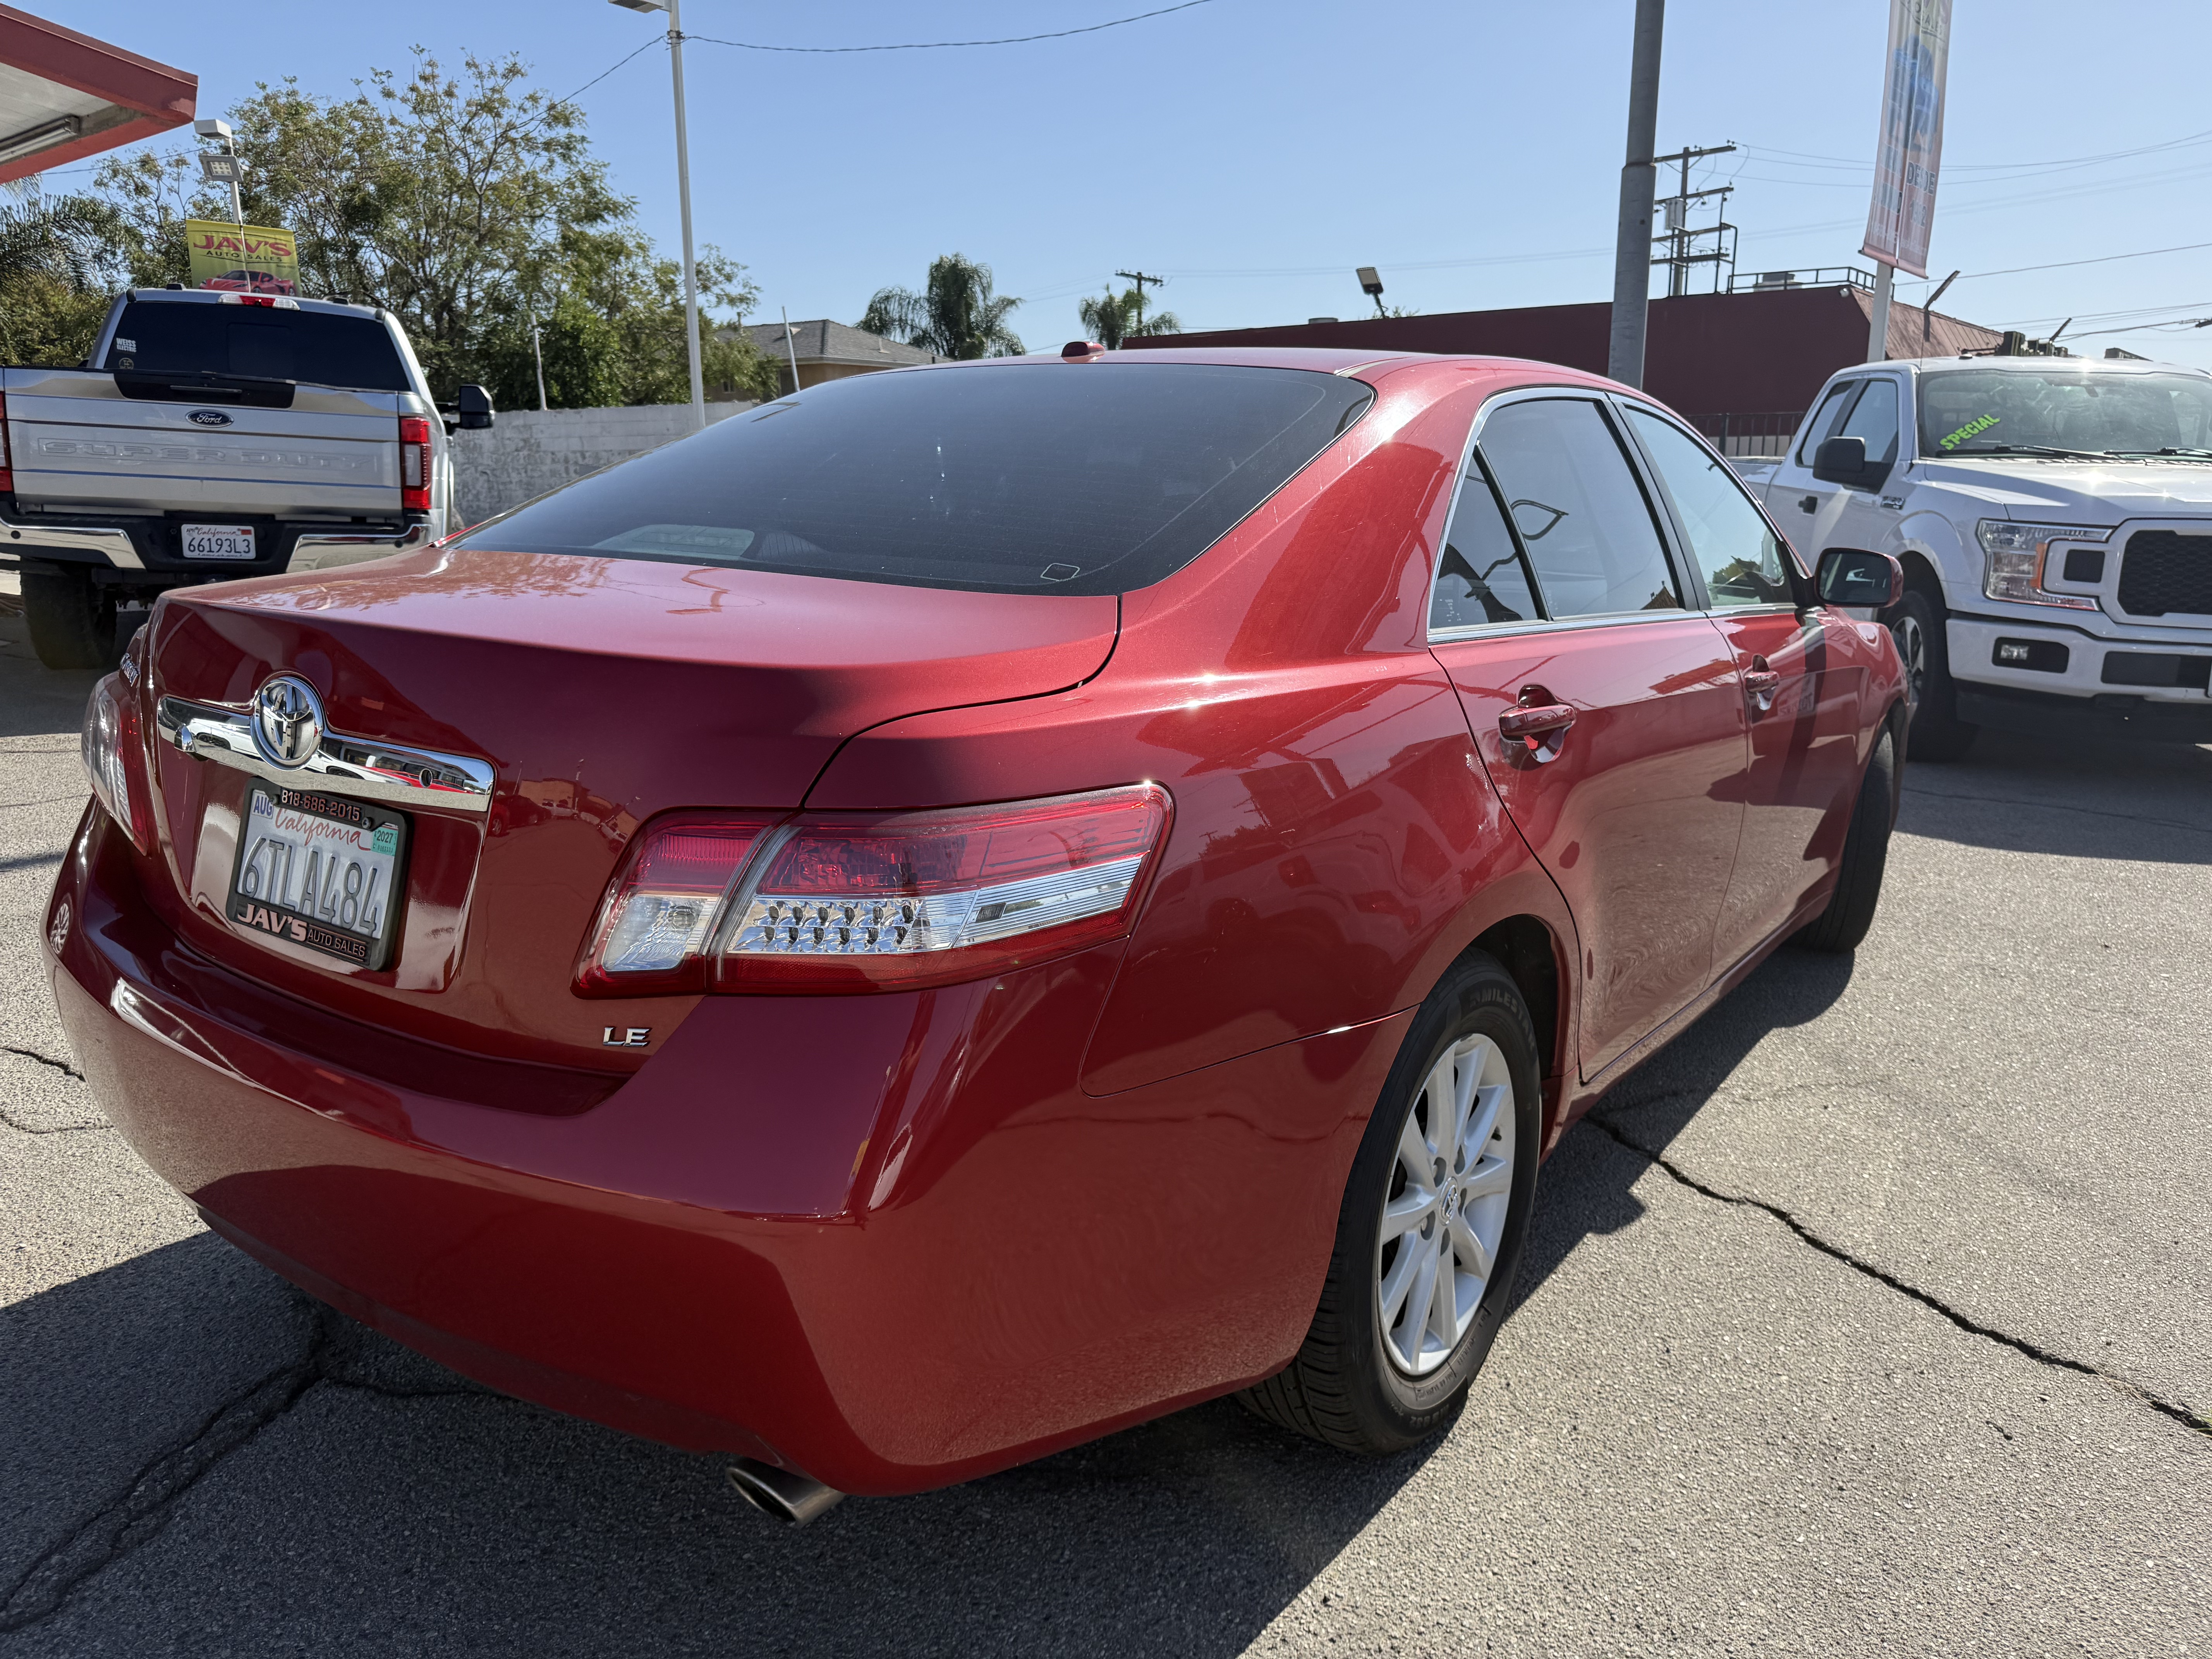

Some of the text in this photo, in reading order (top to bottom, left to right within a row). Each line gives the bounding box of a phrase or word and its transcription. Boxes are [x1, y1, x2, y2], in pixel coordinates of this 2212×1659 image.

[1906, 161, 1936, 196] DEDE
[194, 235, 291, 256] JAV'S
[116, 338, 136, 347] WEISS
[196, 413, 223, 423] Ford
[1939, 414, 2000, 450] SPECIAL
[45, 442, 371, 468] SUPER DUTY
[197, 527, 236, 537] California
[188, 537, 251, 554] 66193L3
[253, 795, 273, 816] AUG
[282, 790, 360, 821] 818-686-2015
[275, 808, 371, 851] California
[376, 830, 394, 844] 2027
[242, 837, 378, 937] 6TLA484
[237, 903, 307, 941] JAV'S
[308, 929, 365, 957] AUTO SALES
[603, 1027, 651, 1047] LE
